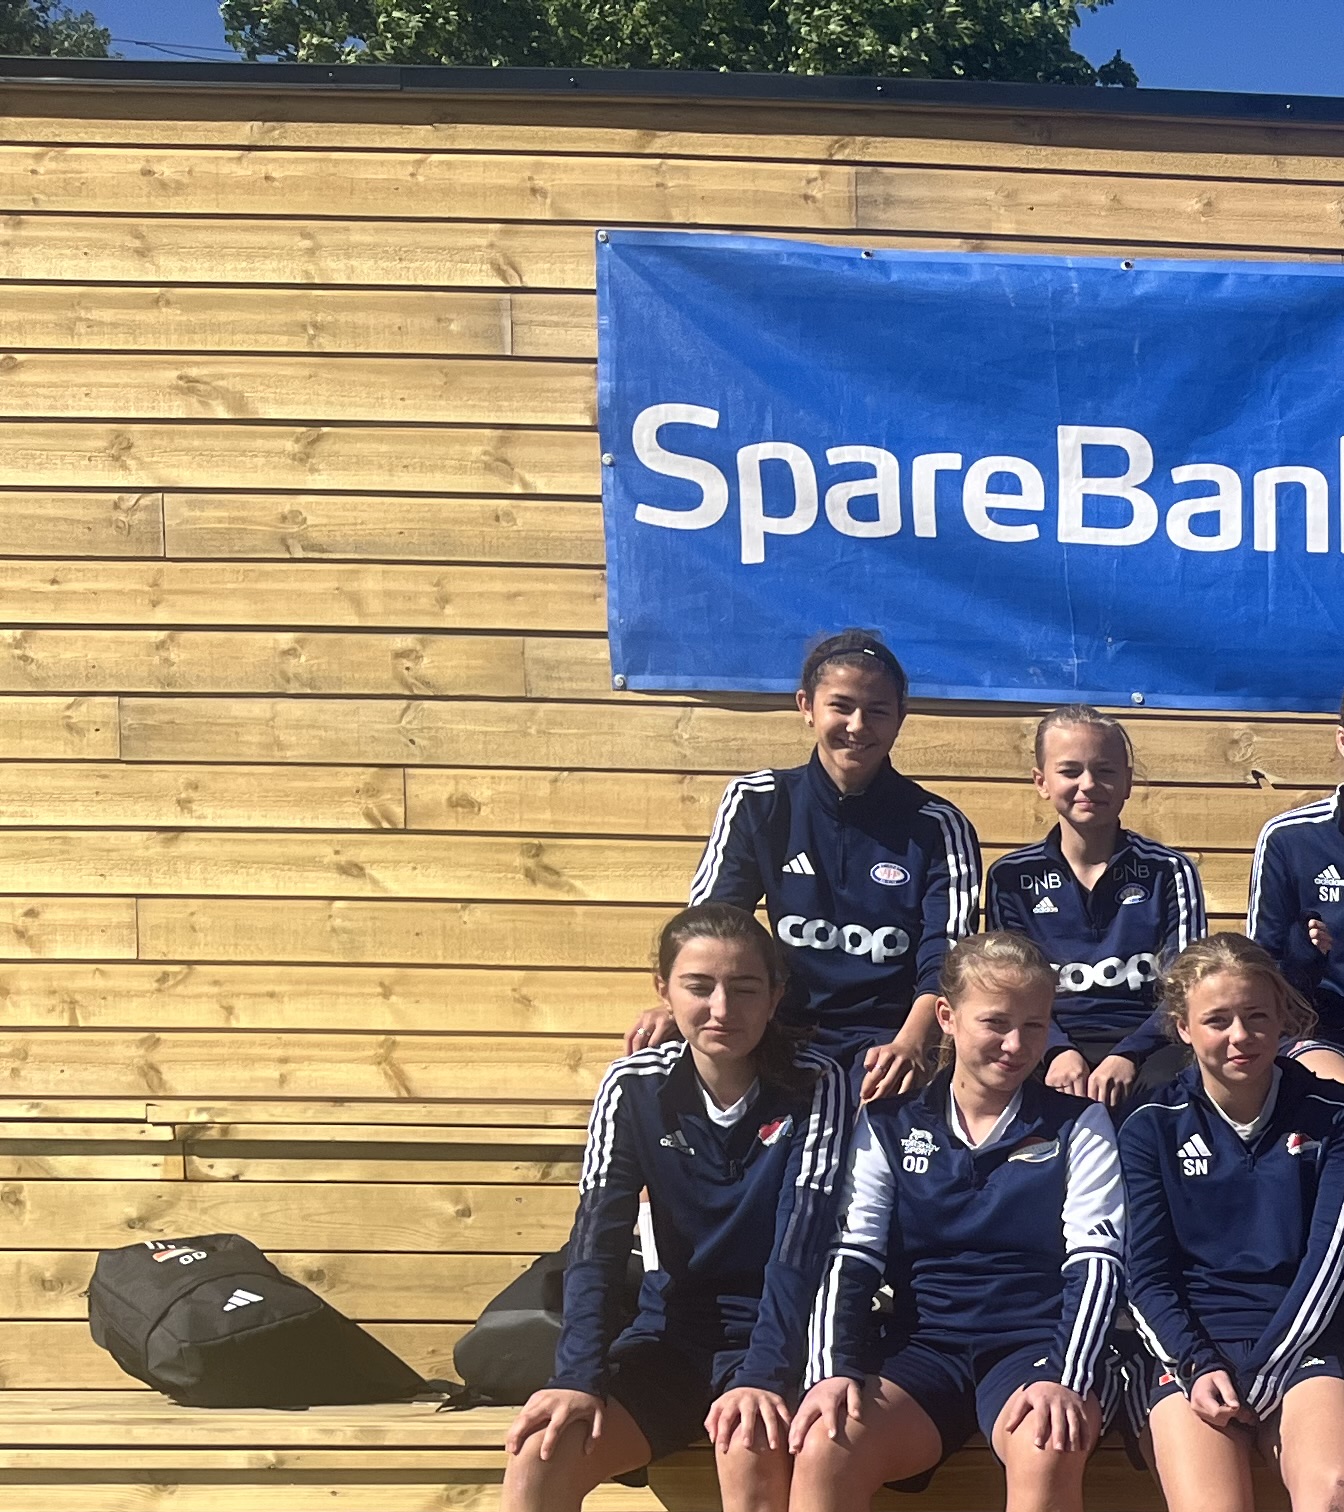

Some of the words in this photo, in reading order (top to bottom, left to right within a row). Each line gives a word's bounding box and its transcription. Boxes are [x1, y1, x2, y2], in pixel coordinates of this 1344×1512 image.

[1113, 859, 1150, 882] DNB
[1020, 869, 1062, 895] DNB
[1319, 885, 1340, 902] SN
[777, 914, 910, 964] coop
[902, 1155, 929, 1174] OD
[1183, 1158, 1209, 1177] SN
